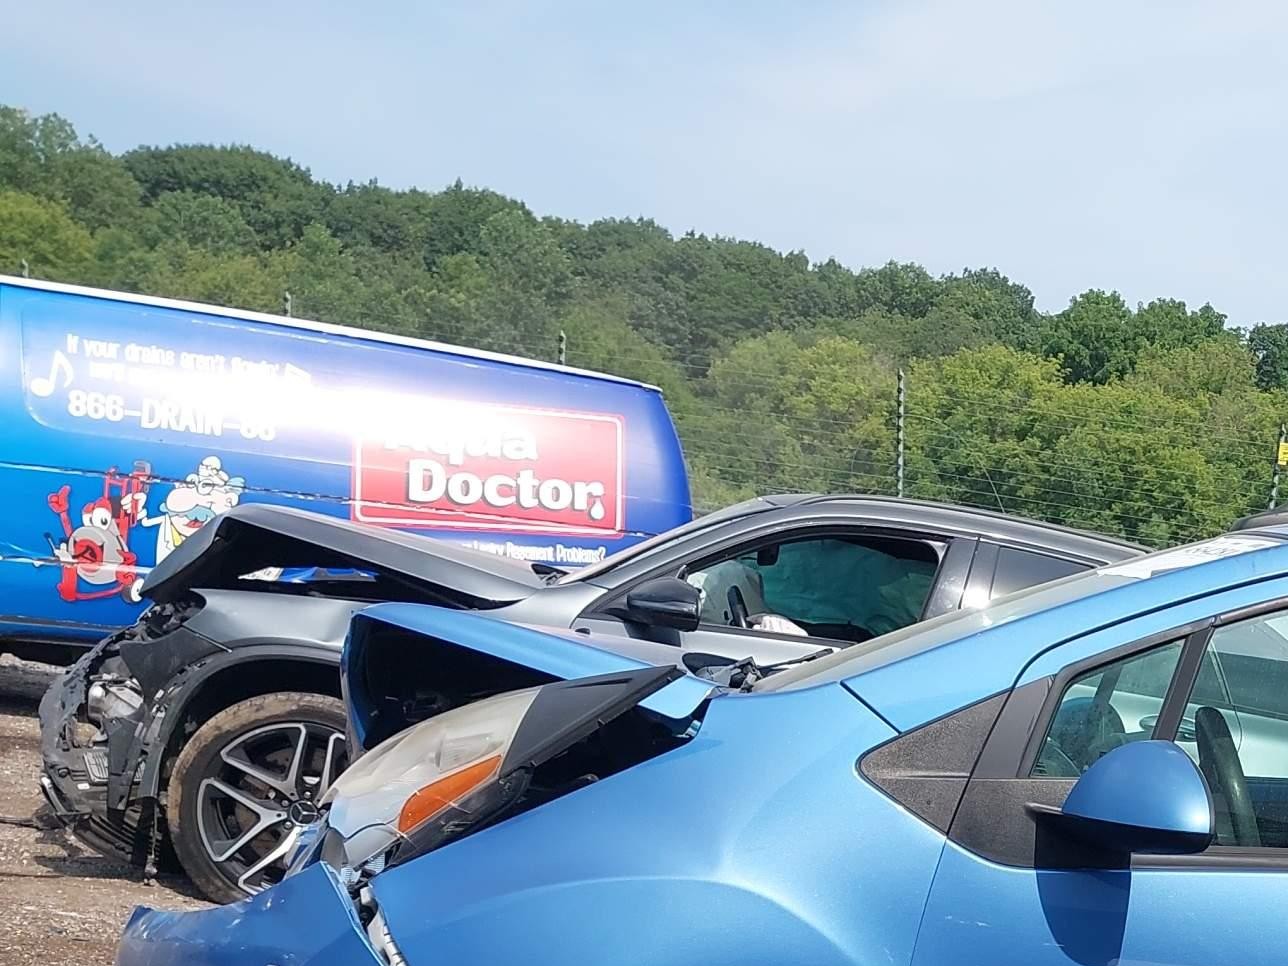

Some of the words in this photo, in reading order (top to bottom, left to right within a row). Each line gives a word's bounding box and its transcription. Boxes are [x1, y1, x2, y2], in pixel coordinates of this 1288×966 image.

[83, 339, 120, 359] your
[124, 342, 176, 367] drains
[407, 458, 605, 511] Doctor
[556, 543, 606, 563] Problems?
